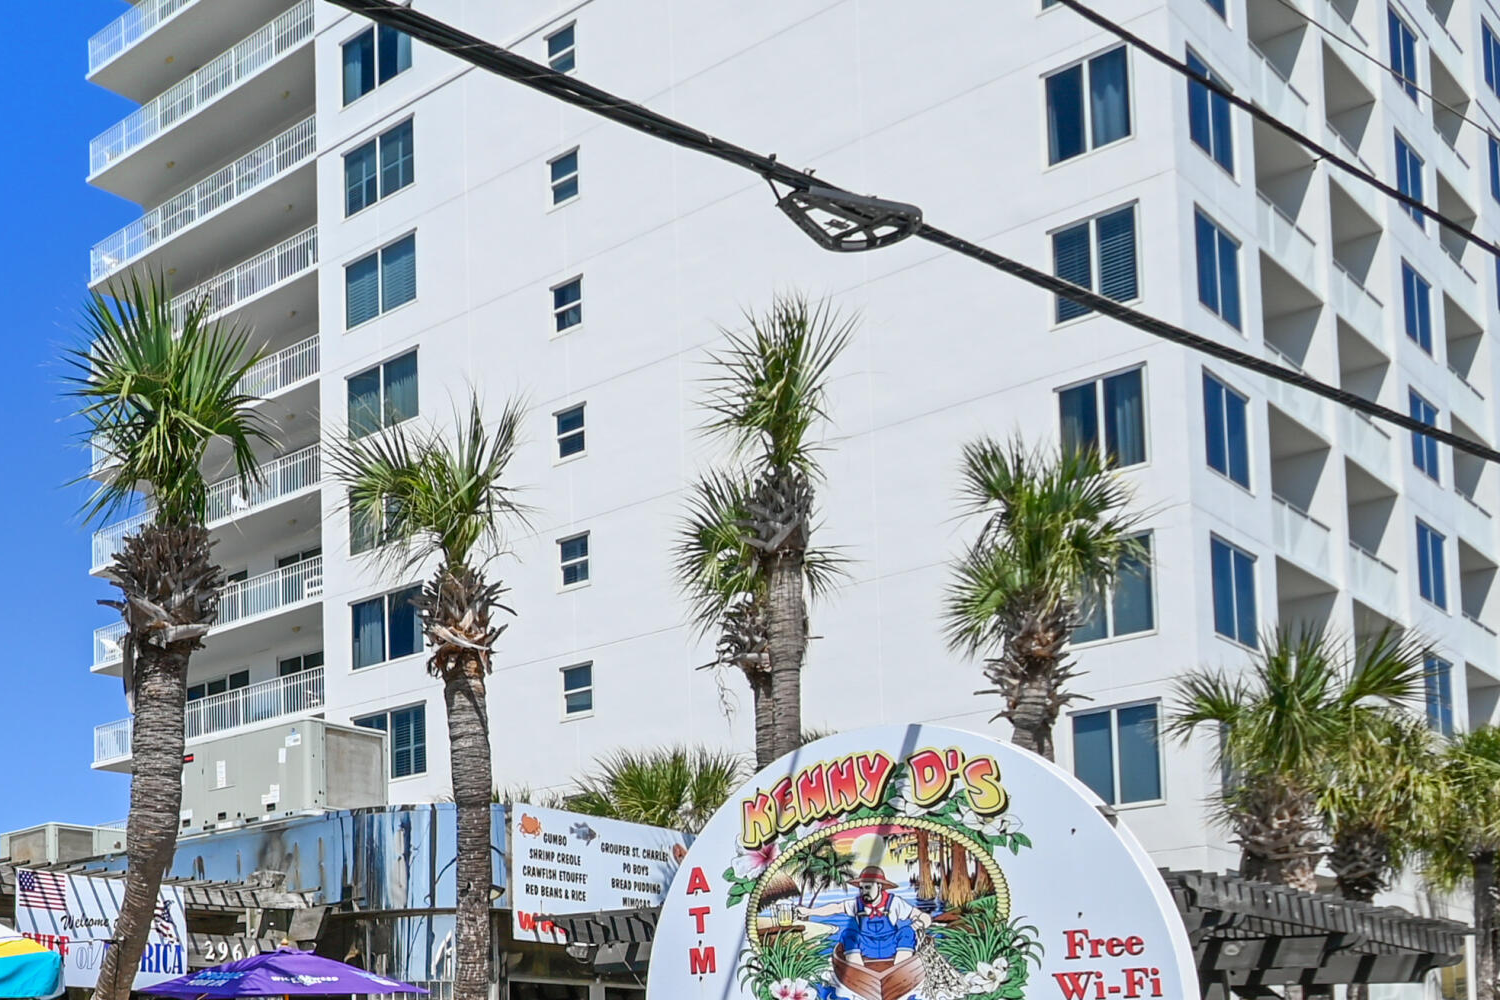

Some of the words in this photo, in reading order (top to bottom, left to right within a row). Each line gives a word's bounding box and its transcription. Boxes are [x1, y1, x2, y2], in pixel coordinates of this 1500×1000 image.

[739, 749, 897, 849] KENNY
[906, 747, 1008, 818] D'S
[543, 832, 567, 847] GUMBO
[529, 848, 555, 862] SHRIMP
[556, 852, 581, 866] CREOLE
[600, 842, 631, 857] GROUPER
[522, 865, 557, 880] CRAWFISH
[623, 862, 631, 874] PO
[525, 883, 539, 896] RED
[540, 885, 563, 899] BEANS
[564, 888, 569, 900] &
[571, 889, 586, 902] RICE
[611, 878, 632, 890] BREAD
[634, 881, 660, 895] PUDDING
[60, 912, 110, 930] Welcome
[686, 867, 716, 975] ATM
[1062, 929, 1144, 960] Free
